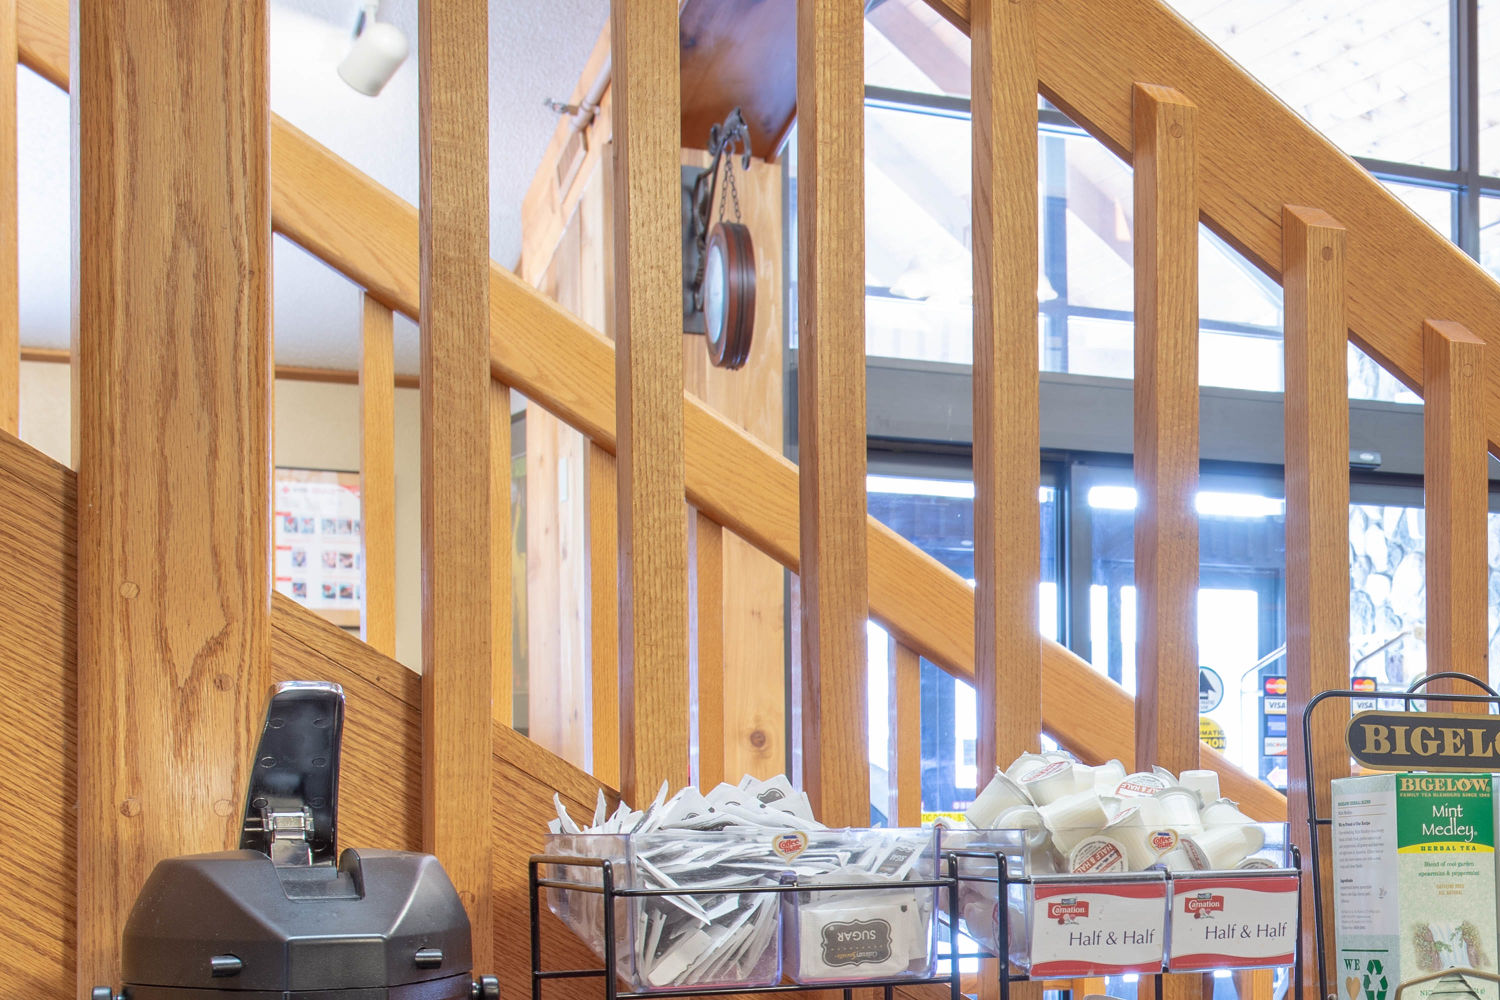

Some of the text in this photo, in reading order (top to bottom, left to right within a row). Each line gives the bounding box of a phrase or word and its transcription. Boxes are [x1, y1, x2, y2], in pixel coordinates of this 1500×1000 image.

[1400, 778, 1488, 792] BIGELOW
[1432, 803, 1463, 817] Mint
[1422, 818, 1474, 842] Medley
[779, 839, 800, 850] Coffee
[1153, 836, 1172, 845] Coffee
[1052, 905, 1085, 915] Carnation
[1188, 900, 1220, 910] Carnation
[838, 930, 876, 941] SUGAR
[1206, 922, 1287, 940] Half & Half
[1069, 929, 1155, 946] Half & Half
[1344, 959, 1360, 970] WE
